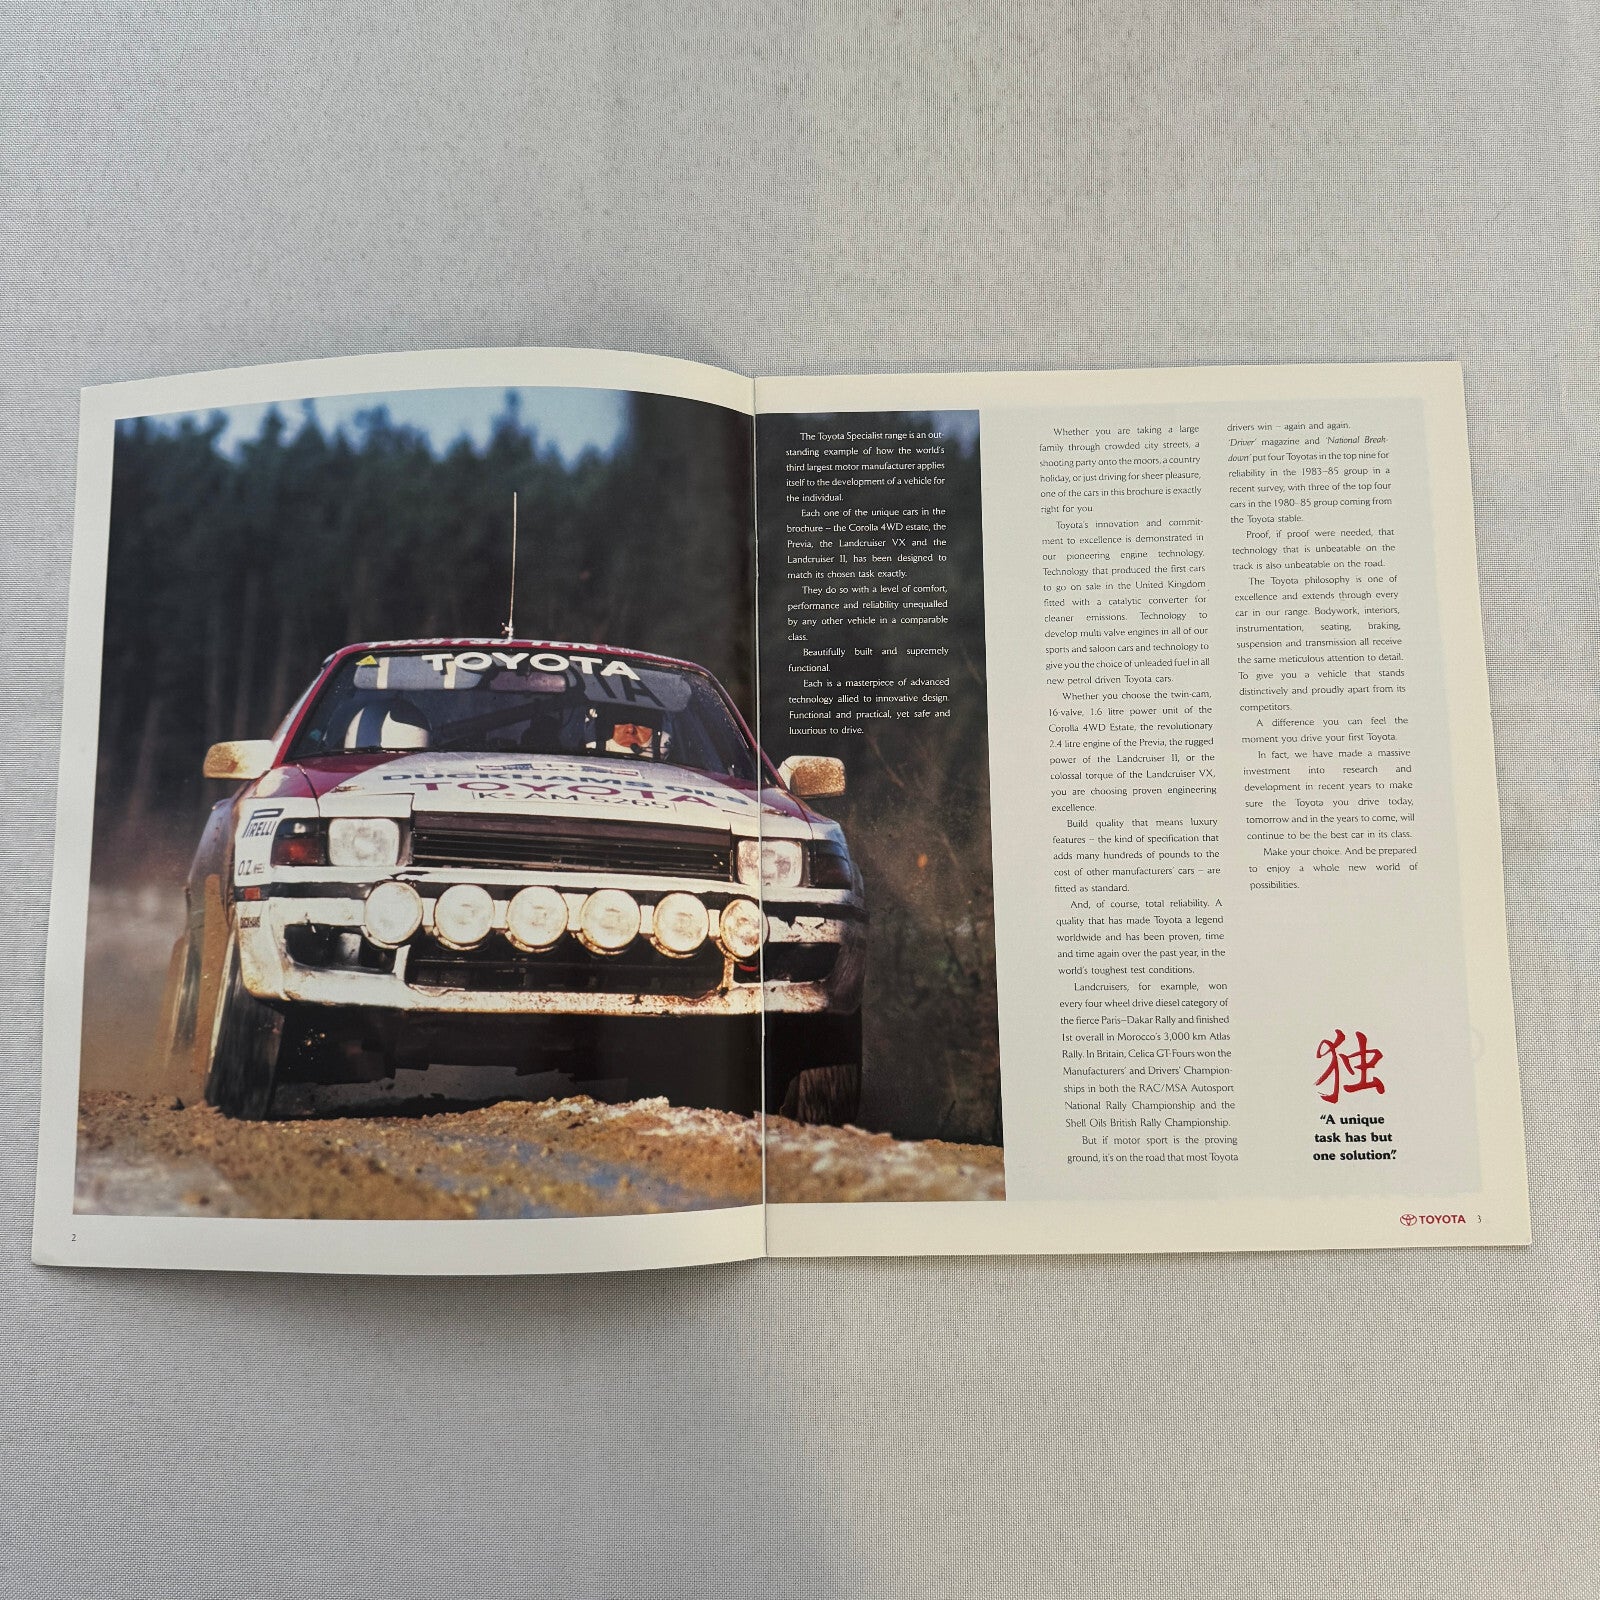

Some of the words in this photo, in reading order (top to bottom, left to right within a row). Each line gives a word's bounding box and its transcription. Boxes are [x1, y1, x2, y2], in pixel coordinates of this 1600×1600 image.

[799, 431, 815, 440] The
[817, 431, 844, 442] Toyota
[846, 430, 883, 441] Specialist
[884, 432, 907, 440] range
[1053, 427, 1089, 436] Whether
[1095, 428, 1111, 436] you
[1136, 425, 1162, 434] taking
[1179, 424, 1200, 434] large
[786, 463, 805, 471] third
[806, 462, 832, 473] largest
[861, 460, 915, 470] manufacturer
[916, 461, 945, 471] applies
[1228, 468, 1266, 479] reliability
[1282, 467, 1296, 476] the
[1343, 467, 1369, 476] group
[1275, 529, 1282, 538] if
[1286, 529, 1309, 539] proof
[1377, 527, 1394, 535] that
[819, 539, 833, 547] the
[839, 538, 886, 547] Landcruiser
[891, 537, 906, 546] VX
[911, 538, 927, 546] and
[933, 537, 946, 545] the
[787, 570, 812, 579] match
[827, 569, 855, 578] chosen
[858, 569, 874, 577] task
[1042, 566, 1089, 577] Technology
[1092, 566, 1108, 575] that
[1110, 565, 1151, 576] produced
[1153, 564, 1168, 573] the
[1170, 565, 1186, 573] first
[787, 600, 839, 611] performance
[842, 600, 858, 609] and
[862, 599, 899, 610] reliability
[902, 599, 948, 610] unequalled
[422, 652, 641, 681] TOYOTA
[803, 678, 823, 687] Each
[845, 679, 894, 688] masterpiece
[897, 677, 907, 686] of
[910, 677, 950, 686] advanced
[1062, 691, 1098, 700] Whether
[1101, 692, 1118, 701] you
[1153, 690, 1168, 699] the
[1238, 686, 1289, 697] distinctively
[1290, 685, 1308, 694] and
[1310, 685, 1345, 696] proudly
[1347, 686, 1369, 694] apart
[1372, 685, 1394, 693] from
[788, 694, 833, 705] technology
[837, 694, 859, 703] allied
[875, 694, 918, 702] innovative
[789, 709, 831, 719] Functional
[835, 710, 851, 718] and
[896, 710, 909, 719] yet
[913, 709, 931, 718] safe
[934, 709, 950, 717] and
[1048, 723, 1079, 732] Corolla
[1082, 722, 1106, 732] 4WD
[1139, 722, 1154, 731] the
[1156, 720, 1213, 732] revolutionary
[1243, 767, 1290, 775] investment
[1308, 766, 1325, 774] into
[1342, 764, 1378, 774] research
[1395, 764, 1412, 773] and
[383, 773, 653, 788] DUCKHAMS
[665, 786, 749, 805] OILS
[410, 782, 718, 808] TOYOTA
[242, 808, 284, 838] PIRELLI
[1245, 816, 1290, 824] tomorrow
[1290, 814, 1308, 823] and
[1320, 814, 1334, 823] the
[1336, 815, 1359, 824] years
[1360, 814, 1370, 822] to
[1399, 812, 1415, 821] will
[1055, 916, 1085, 927] quality
[1088, 916, 1105, 925] that
[1107, 915, 1123, 925] has
[1125, 916, 1150, 924] made
[1153, 914, 1182, 925] Toyota
[1194, 914, 1224, 926] legend
[1091, 965, 1127, 975] toughest
[1130, 966, 1145, 974] test
[1060, 1016, 1074, 1025] the
[1075, 1017, 1100, 1025] fierce
[1154, 1014, 1176, 1026] Rally
[1177, 1014, 1194, 1024] and
[1195, 1014, 1229, 1024] finished
[1062, 1032, 1072, 1041] 1st
[1074, 1032, 1104, 1042] overall
[1163, 1031, 1190, 1041] 3,000
[1192, 1031, 1207, 1040] km
[1209, 1031, 1230, 1040] Atlas
[1313, 1028, 1385, 1104] 独
[1063, 1083, 1085, 1095] ships
[1098, 1083, 1119, 1093] both
[1121, 1083, 1136, 1093] the
[1138, 1082, 1187, 1093] RAC/MSA
[1190, 1082, 1234, 1094] Autosport
[1065, 1117, 1086, 1127] Shell
[1089, 1117, 1107, 1128] Oils
[1110, 1117, 1137, 1127] British
[1140, 1117, 1161, 1129] Rally
[1320, 1114, 1336, 1125] "A
[1340, 1114, 1385, 1127] unique
[1314, 1132, 1341, 1142] task
[1345, 1132, 1367, 1142] has
[1370, 1132, 1393, 1142] but
[1313, 1152, 1336, 1160] one
[1418, 1214, 1467, 1224] TOYOTA
[1476, 1214, 1482, 1223] 3
[71, 1233, 77, 1242] 2
